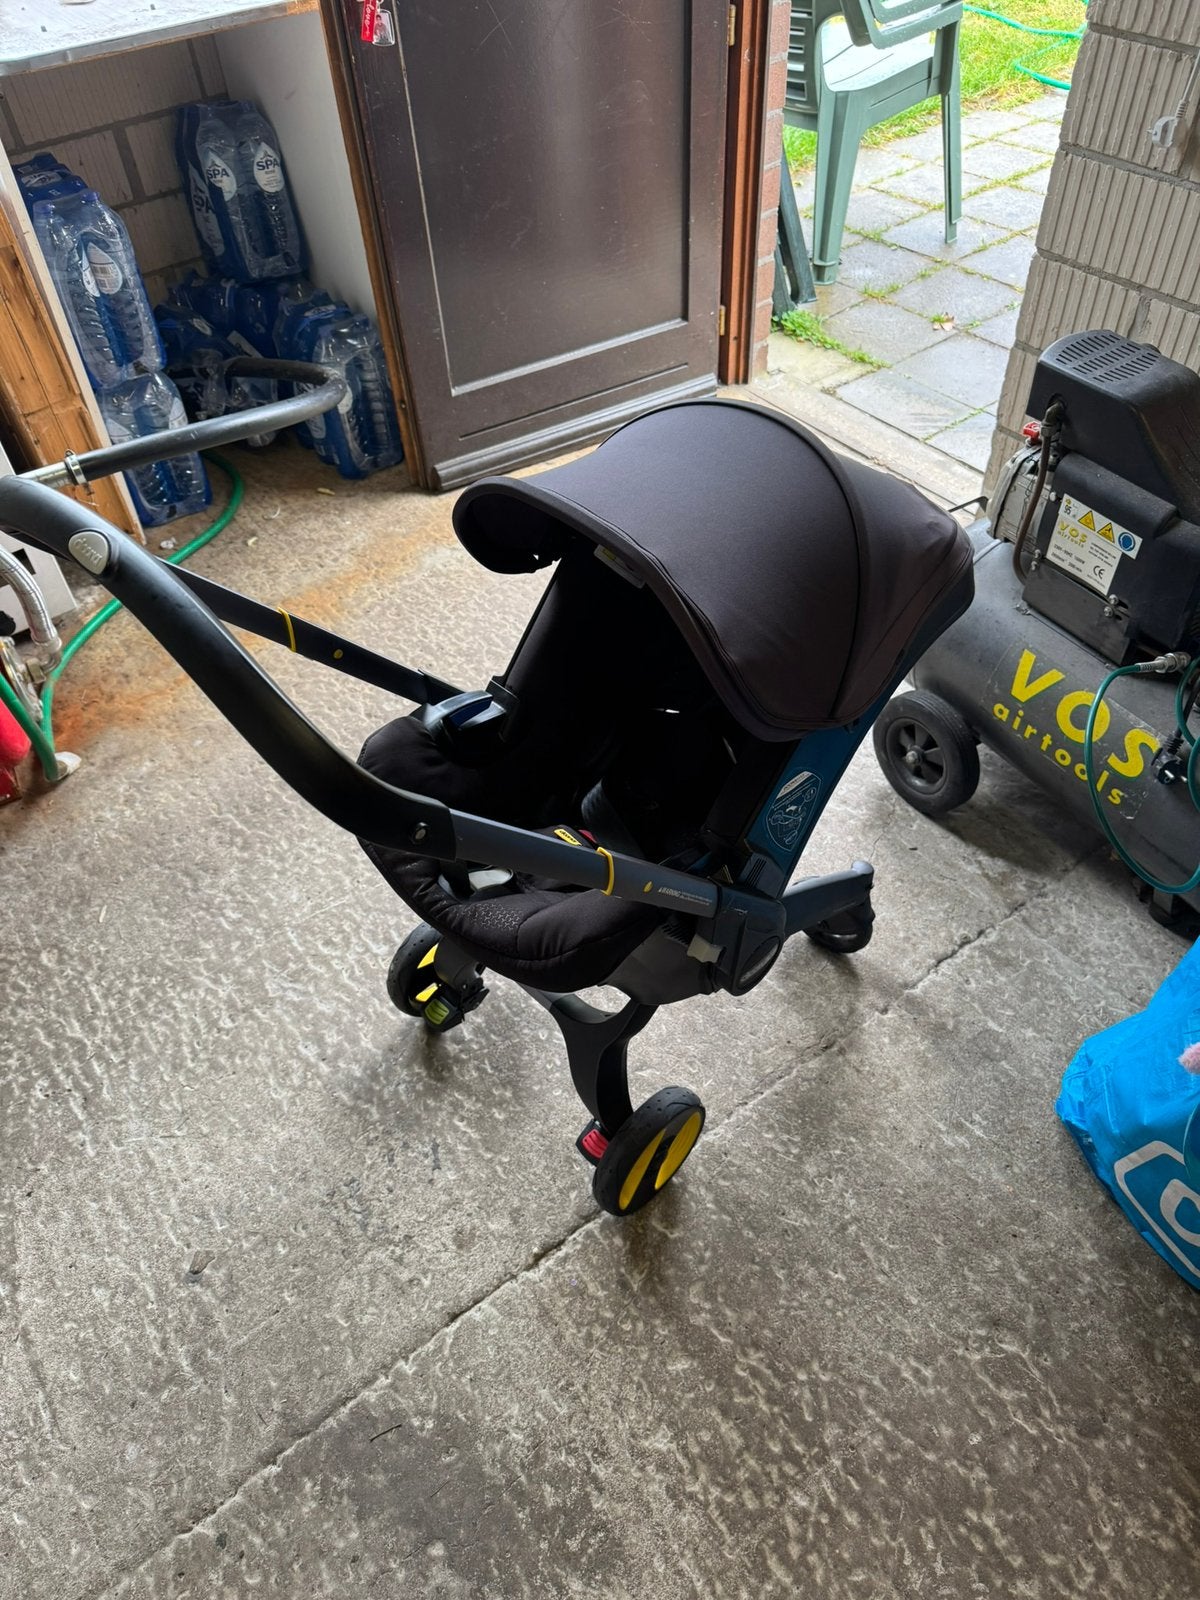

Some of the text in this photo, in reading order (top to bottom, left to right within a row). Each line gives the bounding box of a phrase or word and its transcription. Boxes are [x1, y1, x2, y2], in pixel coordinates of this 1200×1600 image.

[206, 168, 230, 180] SPA
[256, 158, 280, 171] SPA
[1058, 520, 1088, 543] VOS
[1011, 649, 1161, 778] VOS
[993, 703, 1124, 805] airtools
